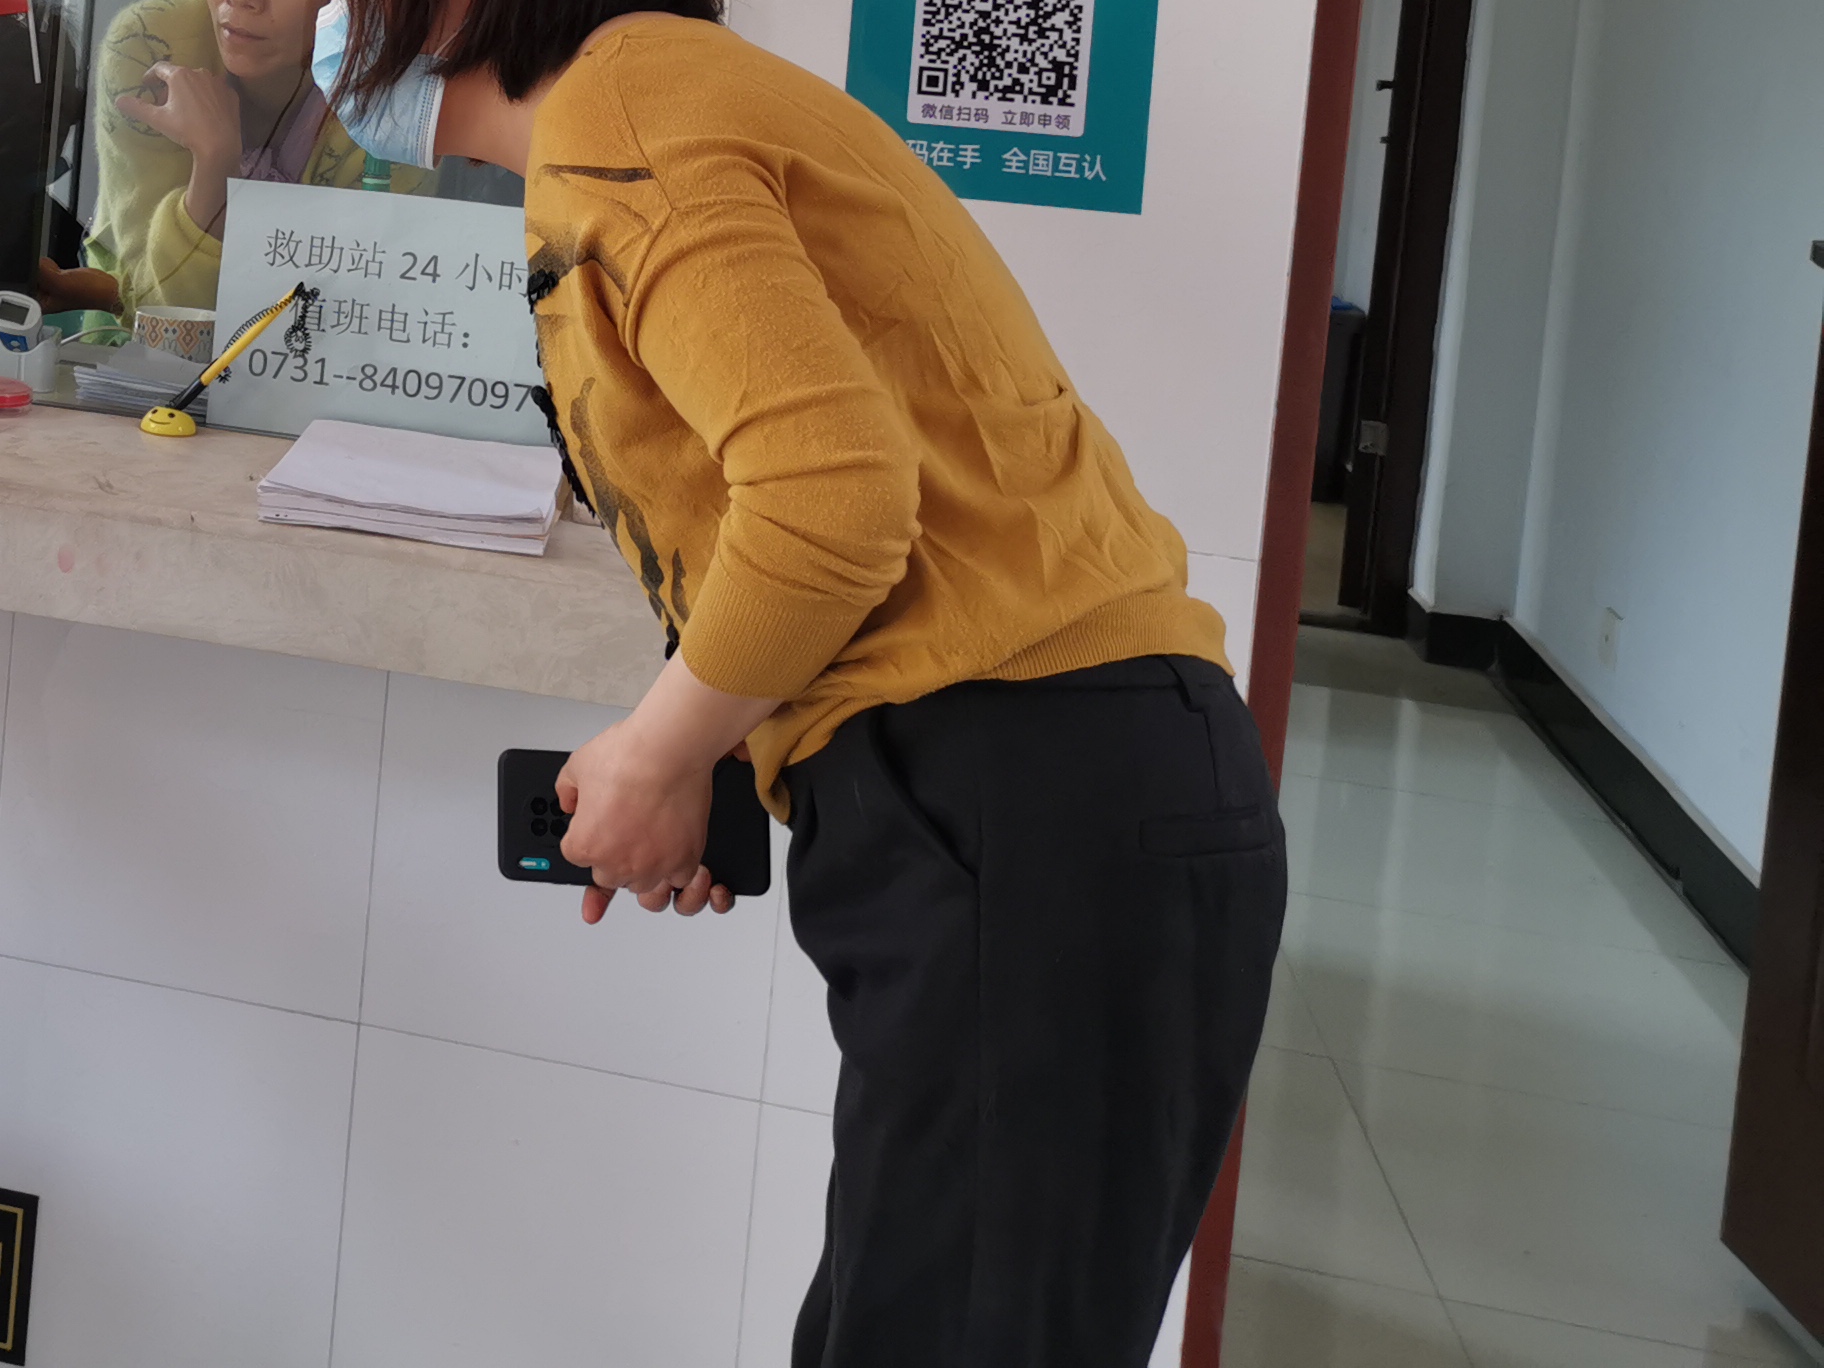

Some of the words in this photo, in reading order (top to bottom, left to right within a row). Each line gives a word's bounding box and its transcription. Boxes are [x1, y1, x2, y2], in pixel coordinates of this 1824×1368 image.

[921, 103, 990, 124] 微信扫码
[1001, 110, 1072, 131] 立即申领
[1001, 147, 1107, 181] 全国互认
[264, 228, 387, 280] 救助站
[398, 251, 441, 283] 24
